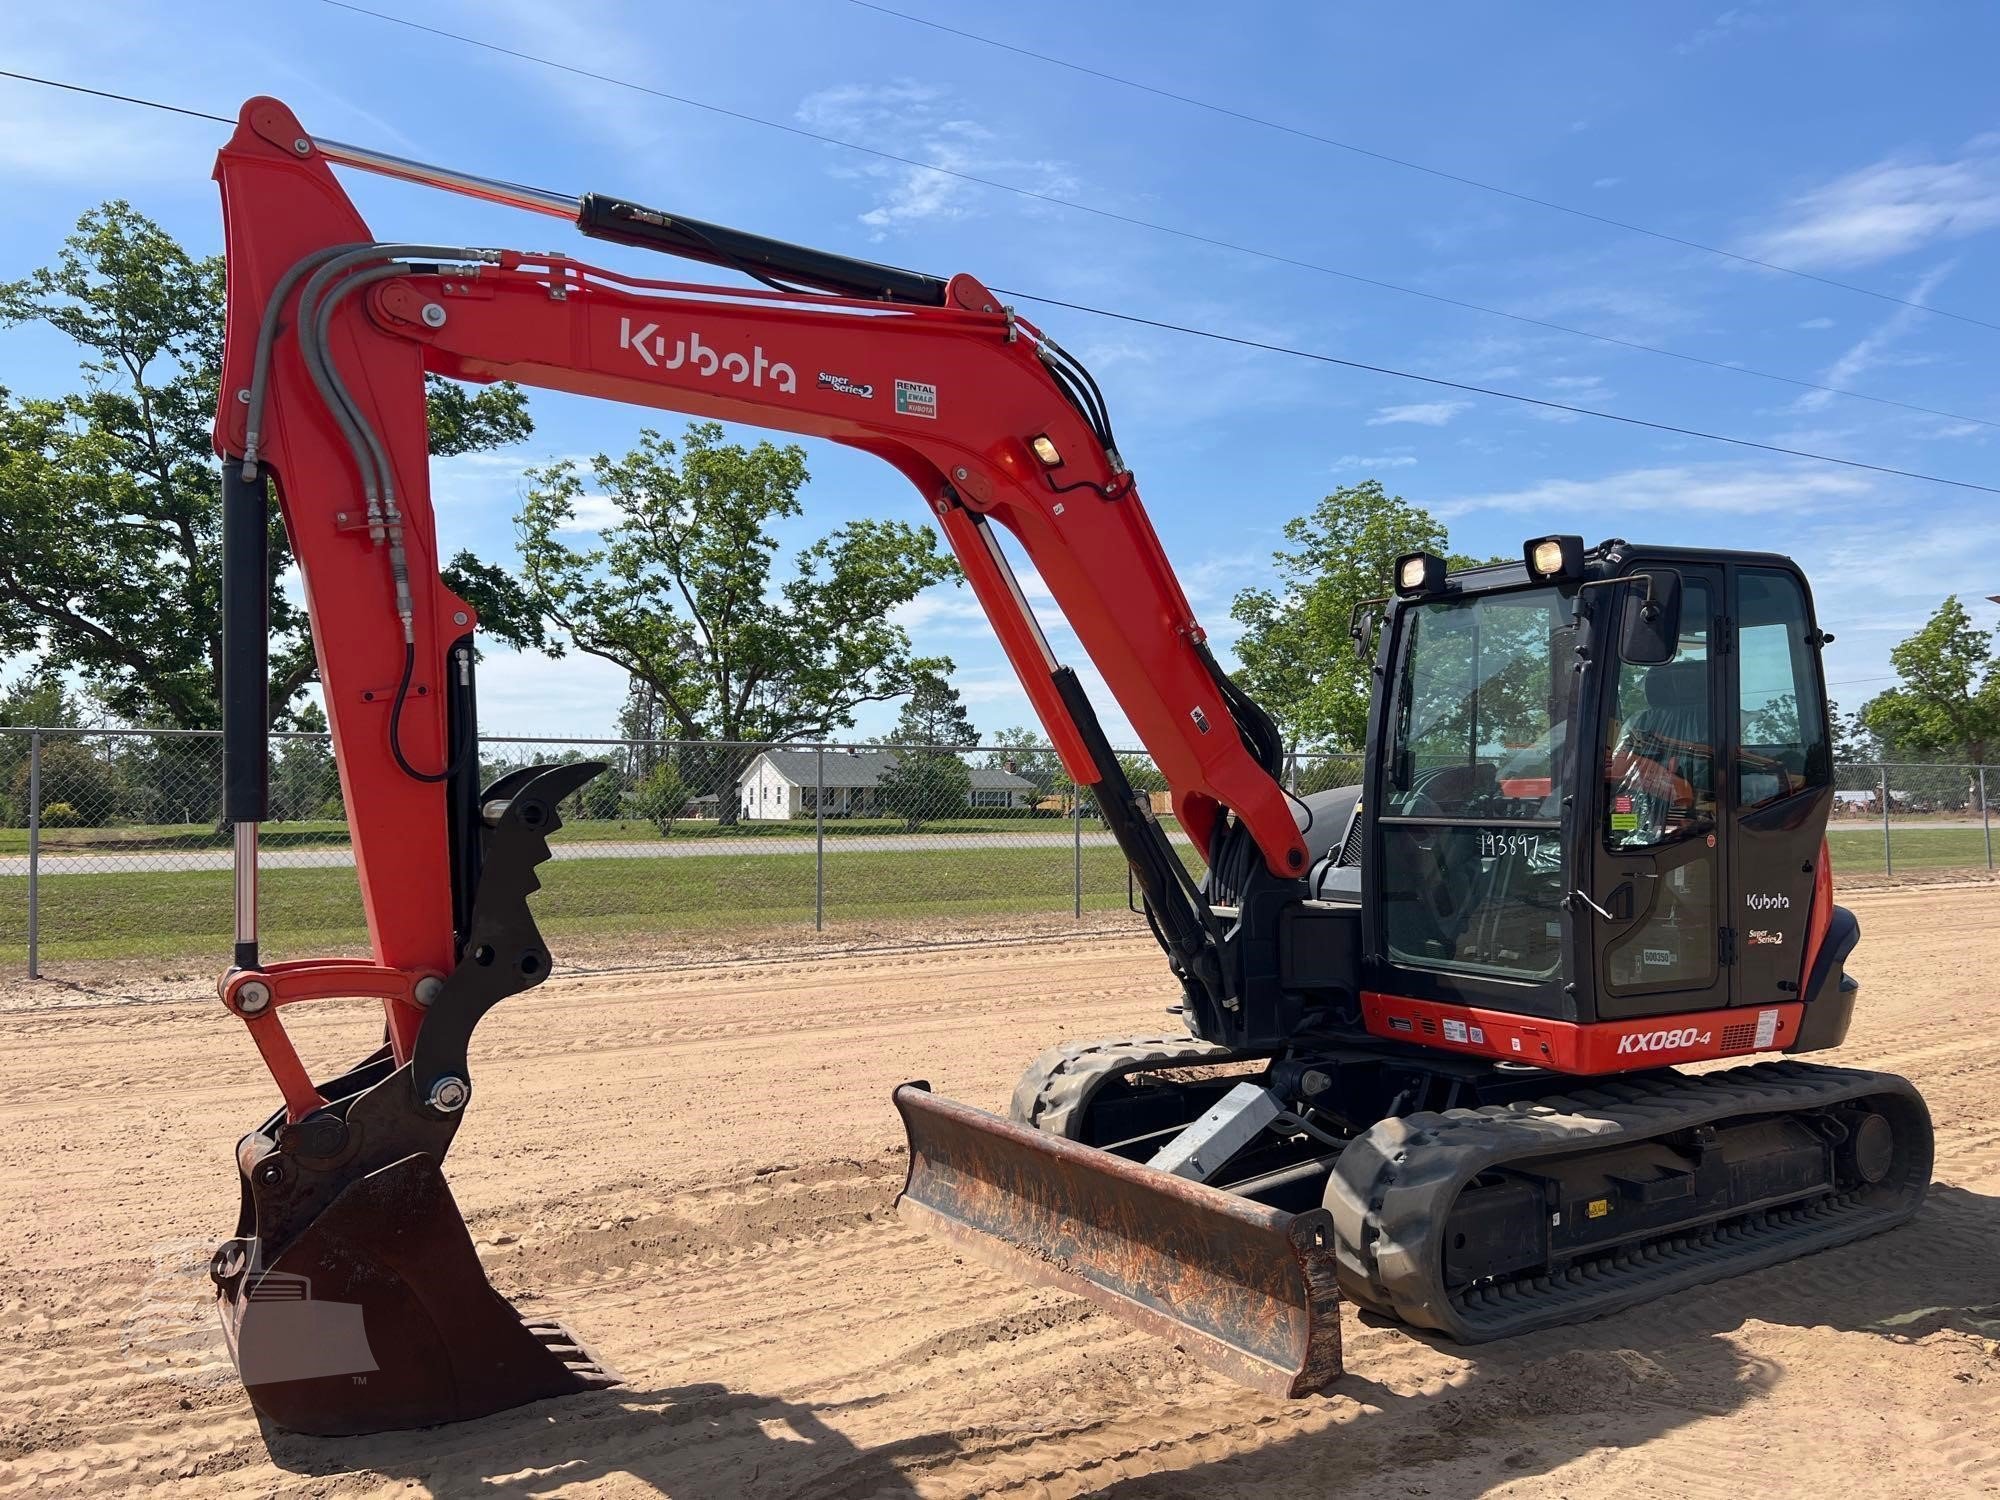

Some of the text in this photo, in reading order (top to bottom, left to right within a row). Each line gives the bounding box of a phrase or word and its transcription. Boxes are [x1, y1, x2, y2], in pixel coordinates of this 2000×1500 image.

[620, 317, 797, 394] Kubota
[818, 372, 849, 385] Super
[896, 381, 935, 394] RENTAL
[907, 393, 933, 403] EWALD
[908, 404, 934, 414] KUBOTA
[1481, 834, 1539, 860] 193897
[1746, 892, 1790, 910] Kubota
[1748, 929, 1768, 939] Super
[1616, 1028, 1712, 1054] KX080-4
